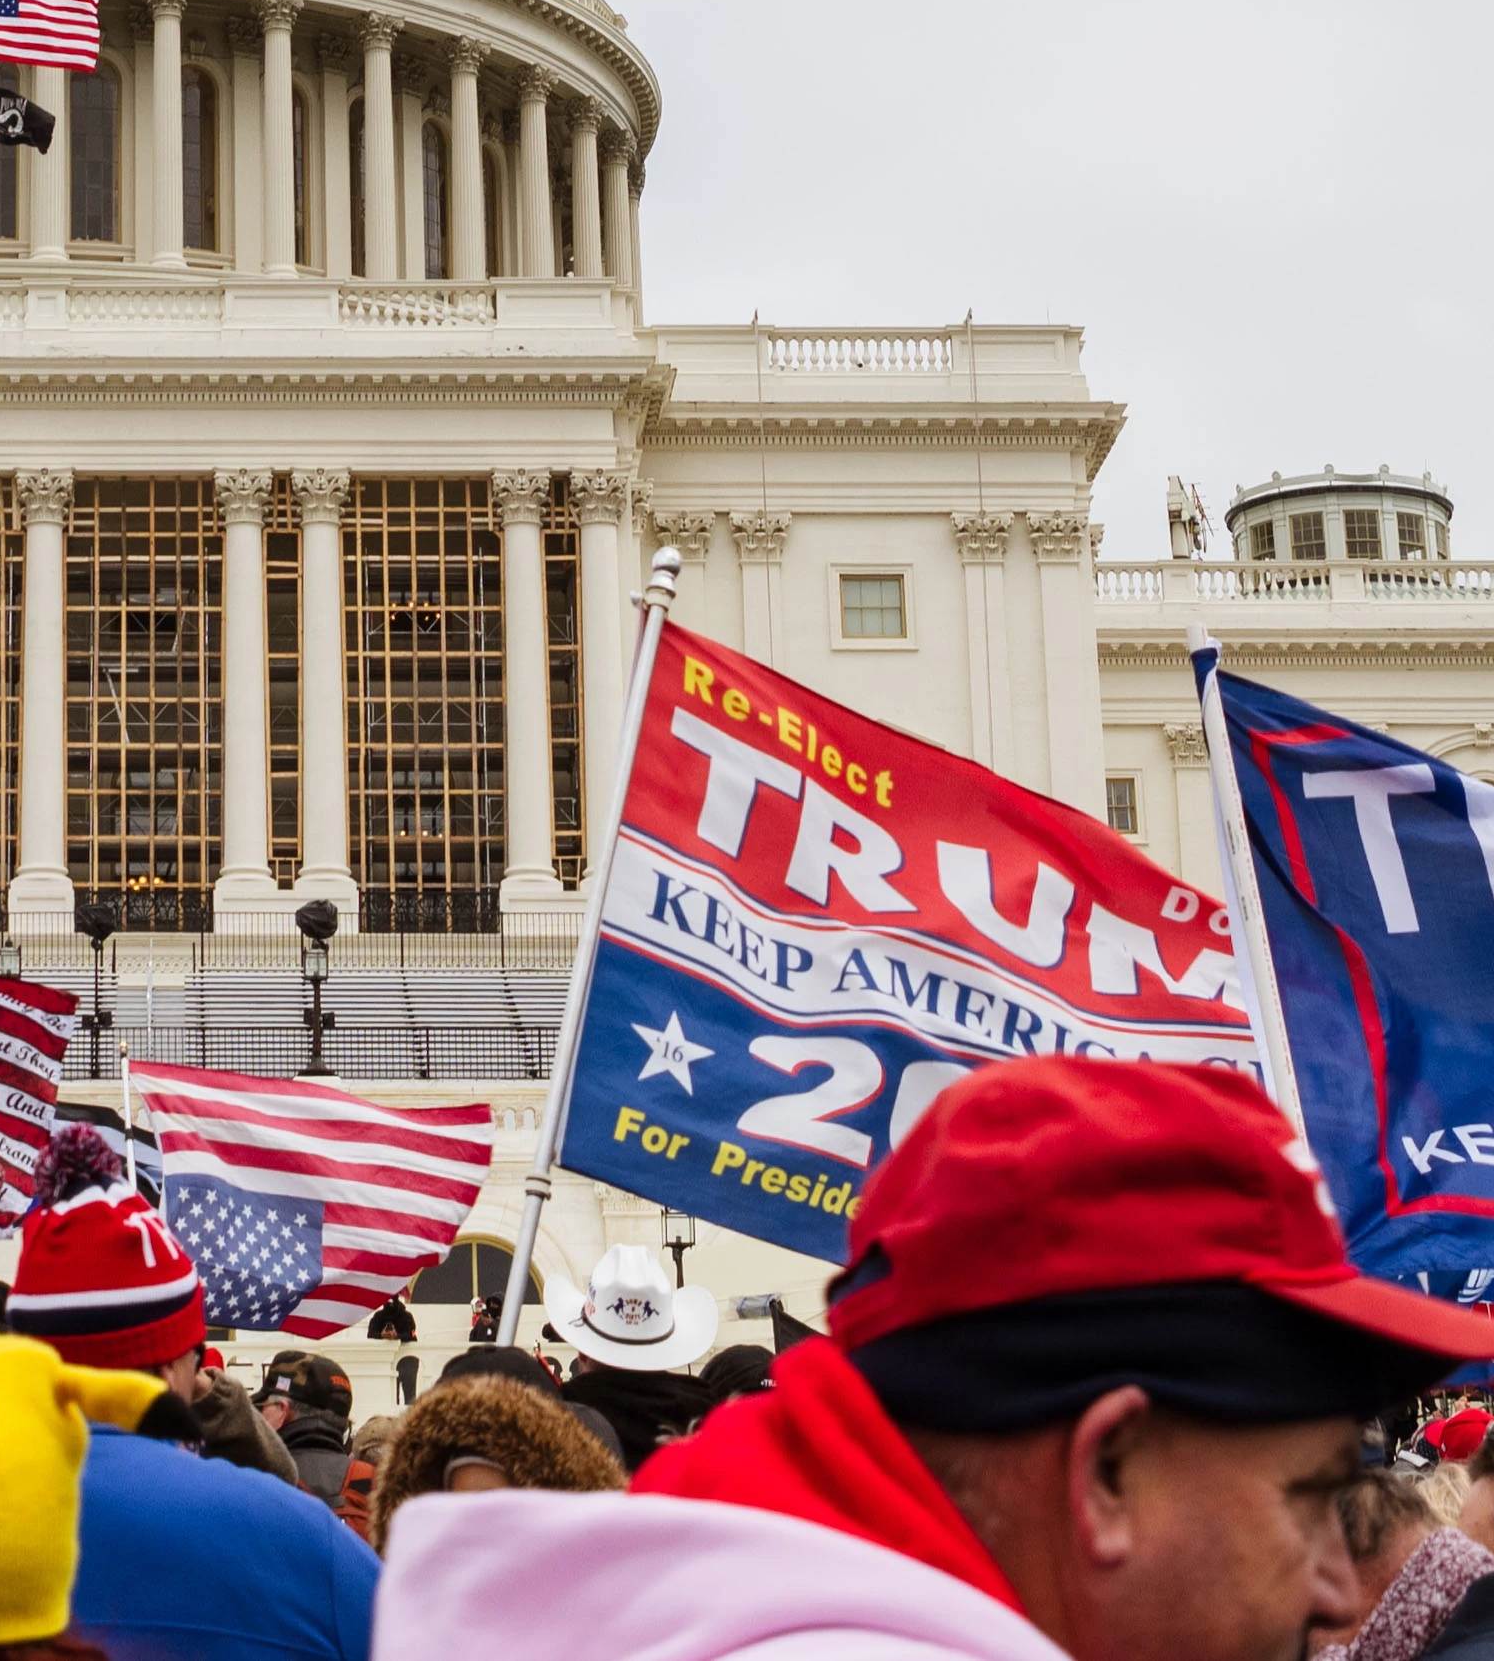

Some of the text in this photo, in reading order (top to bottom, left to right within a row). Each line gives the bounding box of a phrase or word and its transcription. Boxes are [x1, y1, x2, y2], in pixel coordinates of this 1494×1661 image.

[682, 655, 895, 809] Re-Elect
[670, 706, 1247, 1015] TRUM
[646, 869, 814, 993] KEEP
[14, 1045, 56, 1080] They
[39, 1011, 67, 1033] Be
[5, 1090, 48, 1122] And
[613, 1105, 862, 1221] For Preside
